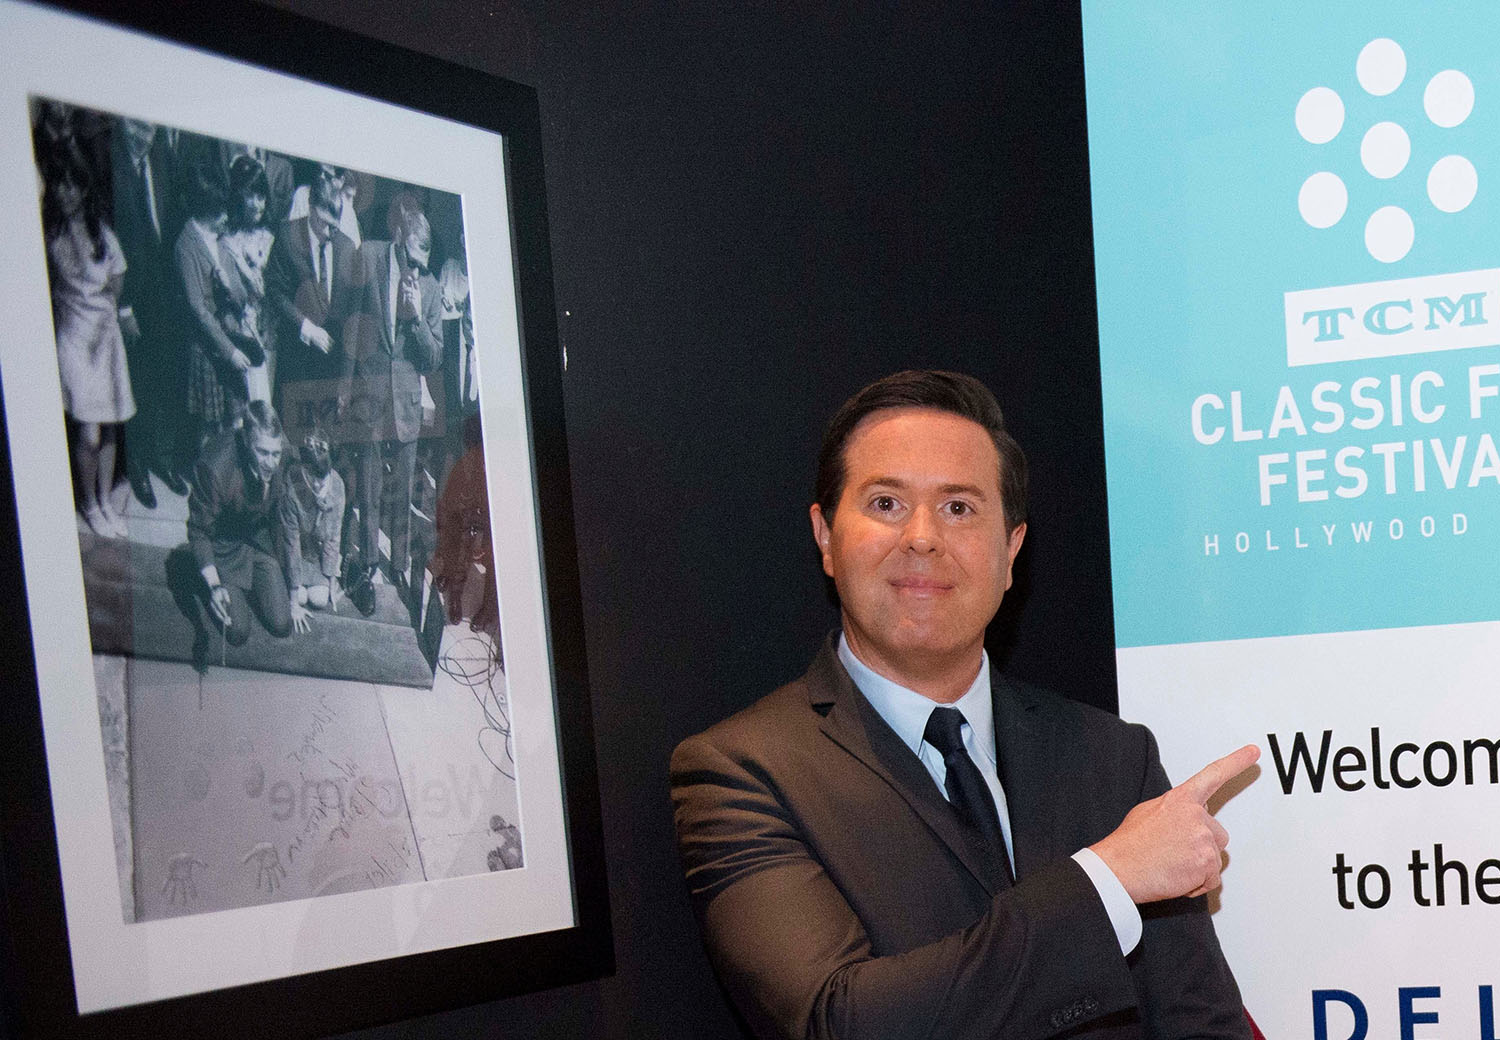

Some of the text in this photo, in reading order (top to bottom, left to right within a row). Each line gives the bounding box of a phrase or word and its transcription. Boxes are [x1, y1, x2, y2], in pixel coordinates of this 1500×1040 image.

[1302, 292, 1488, 342] TCM
[1191, 371, 1446, 446] CLASSIC
[1204, 513, 1468, 556] HOLLYWOOD
[1331, 853, 1391, 910] to
